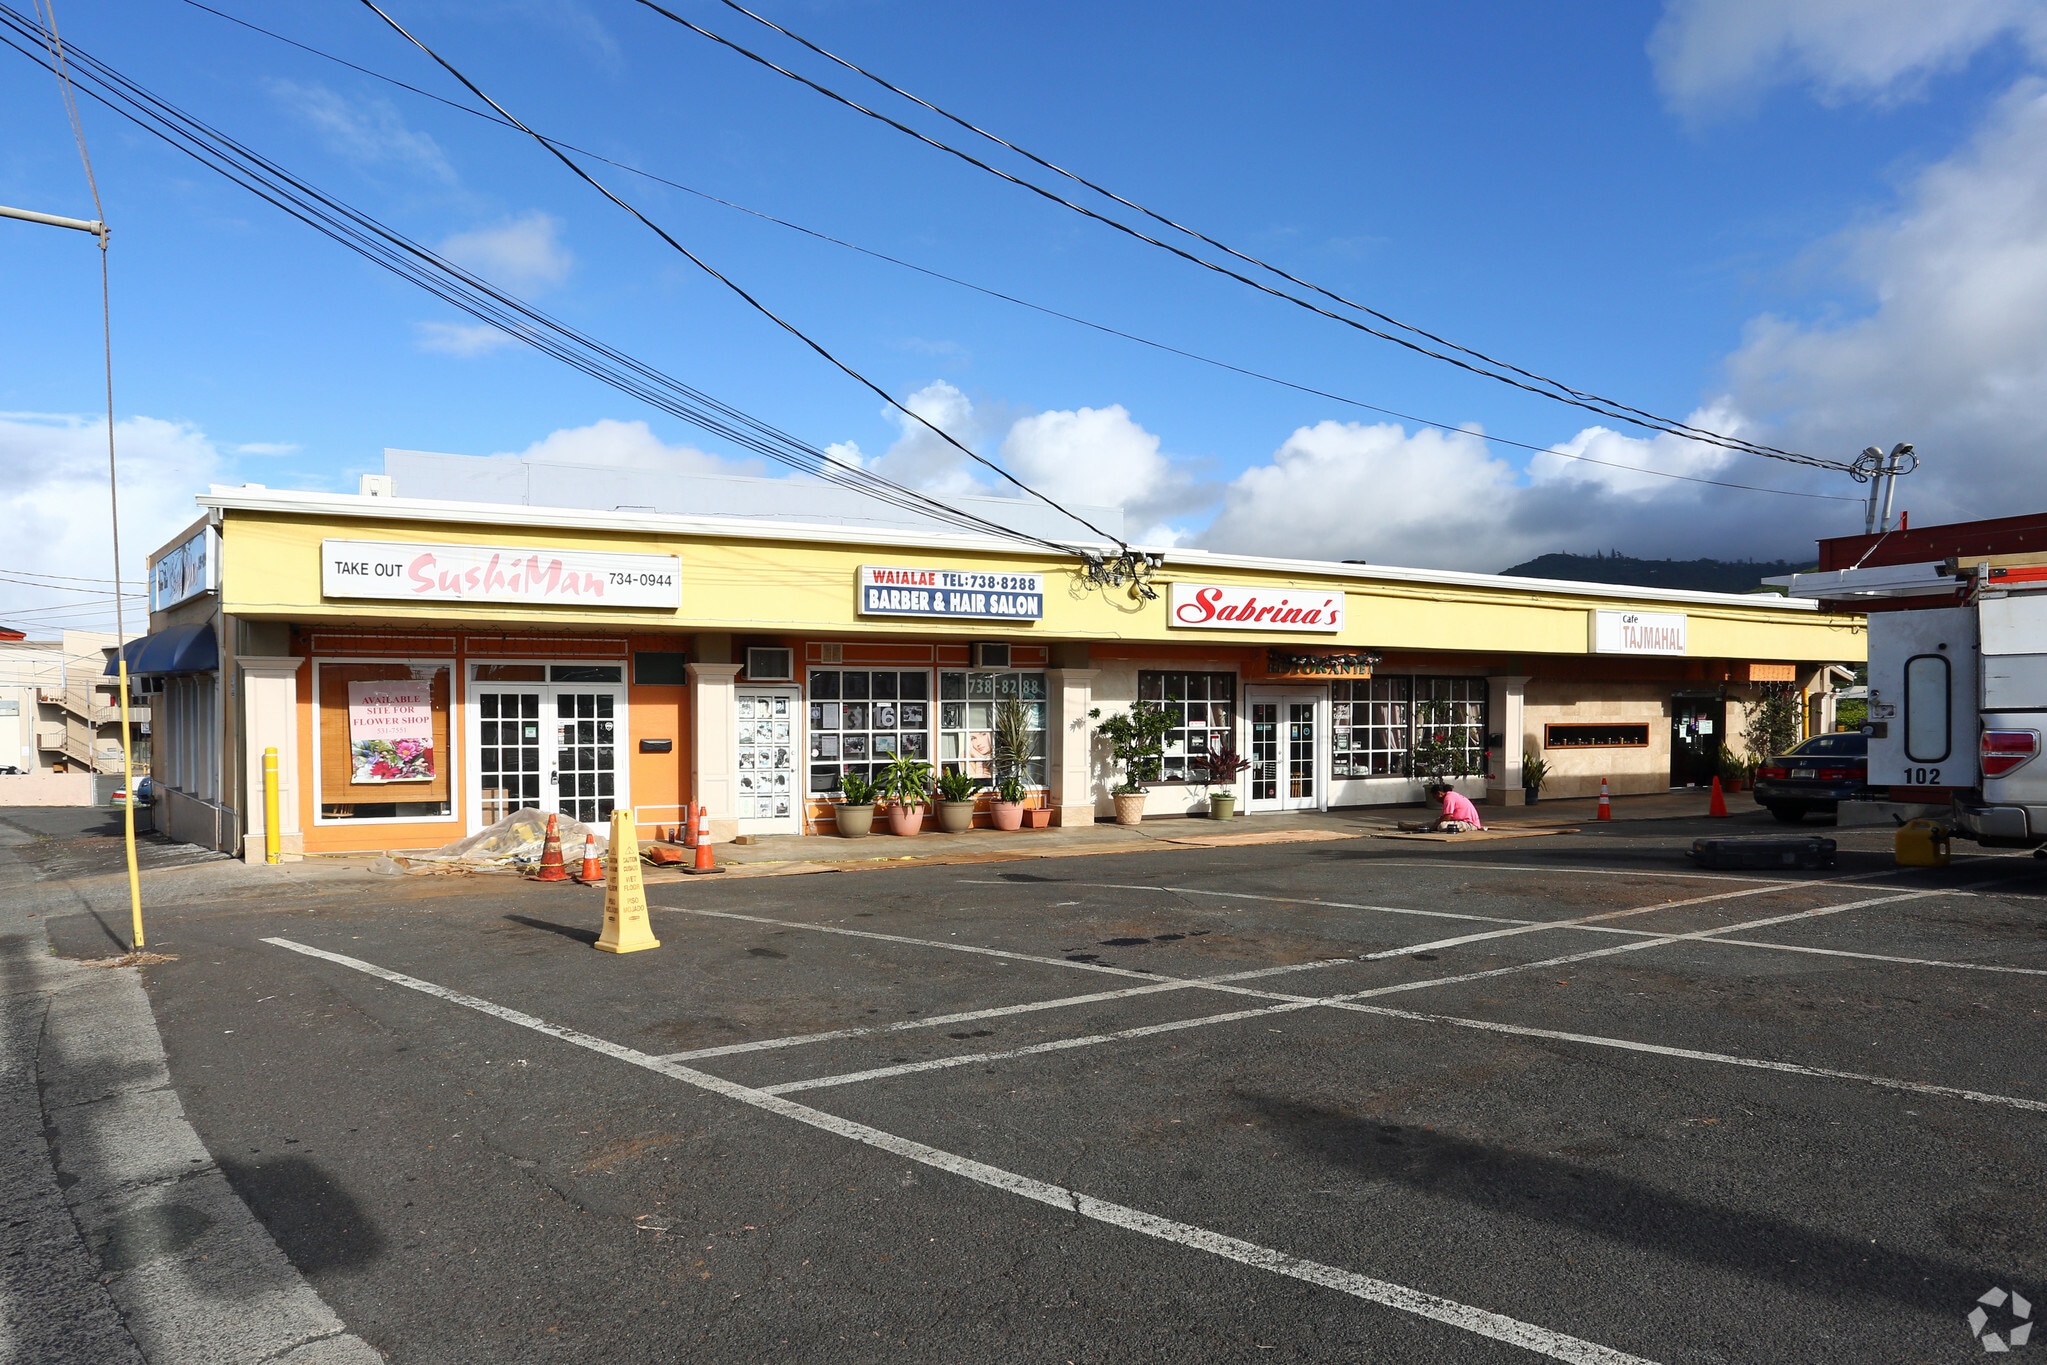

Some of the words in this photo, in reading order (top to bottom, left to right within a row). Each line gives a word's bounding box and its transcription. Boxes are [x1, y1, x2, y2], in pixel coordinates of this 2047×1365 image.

[335, 561, 369, 576] TAKE
[375, 563, 403, 577] OUT
[408, 553, 604, 597] SushiMan
[609, 572, 673, 587] 734-0944
[873, 570, 936, 586] WAIALAE
[869, 589, 930, 611] BARBER
[933, 592, 946, 611] &
[950, 593, 986, 613] HAIR
[990, 595, 1038, 615] SALON
[1176, 587, 1341, 626] Sabrina's
[1622, 614, 1639, 624] Cafe
[1623, 625, 1684, 650] TAJMAHAL
[968, 679, 1039, 694] 738-8288
[362, 695, 421, 705] AVAILABLE
[367, 706, 390, 714] SITE
[393, 706, 415, 714] FOR
[353, 718, 399, 726] FLOWER
[402, 716, 430, 724] SHOP
[1904, 767, 1940, 785] 102
